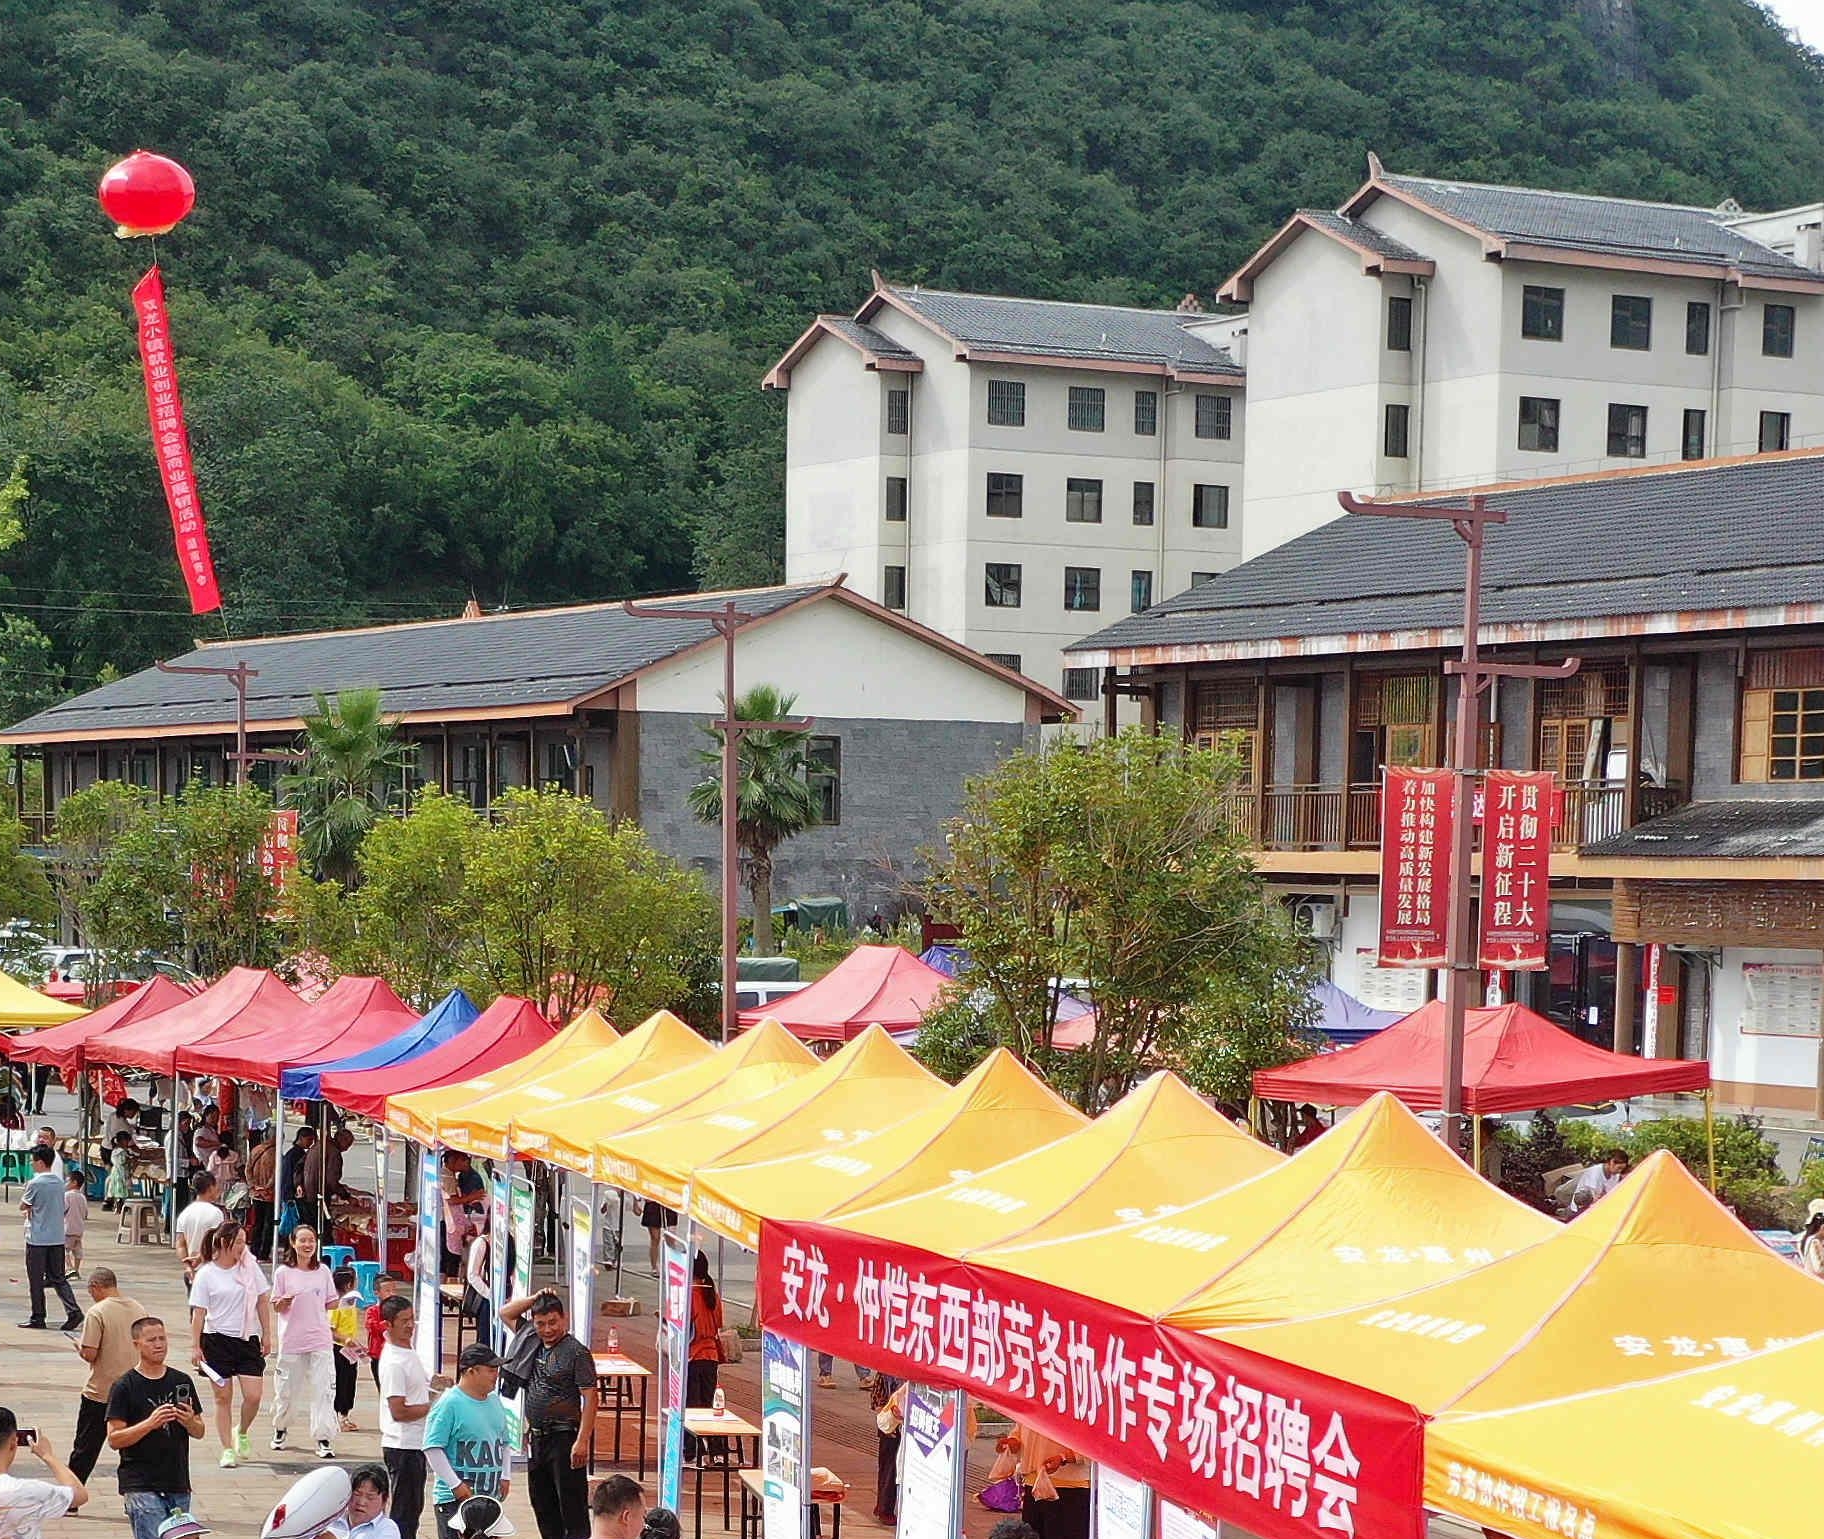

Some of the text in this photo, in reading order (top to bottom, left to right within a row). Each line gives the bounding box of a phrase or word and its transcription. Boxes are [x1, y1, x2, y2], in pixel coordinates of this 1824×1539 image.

[1396, 779, 1418, 926] 着力推动高质量发展
[1416, 779, 1436, 926] 加快构建新发展格局
[1494, 784, 1517, 928] 开启新征程
[1515, 784, 1539, 928] 贯彻二十大
